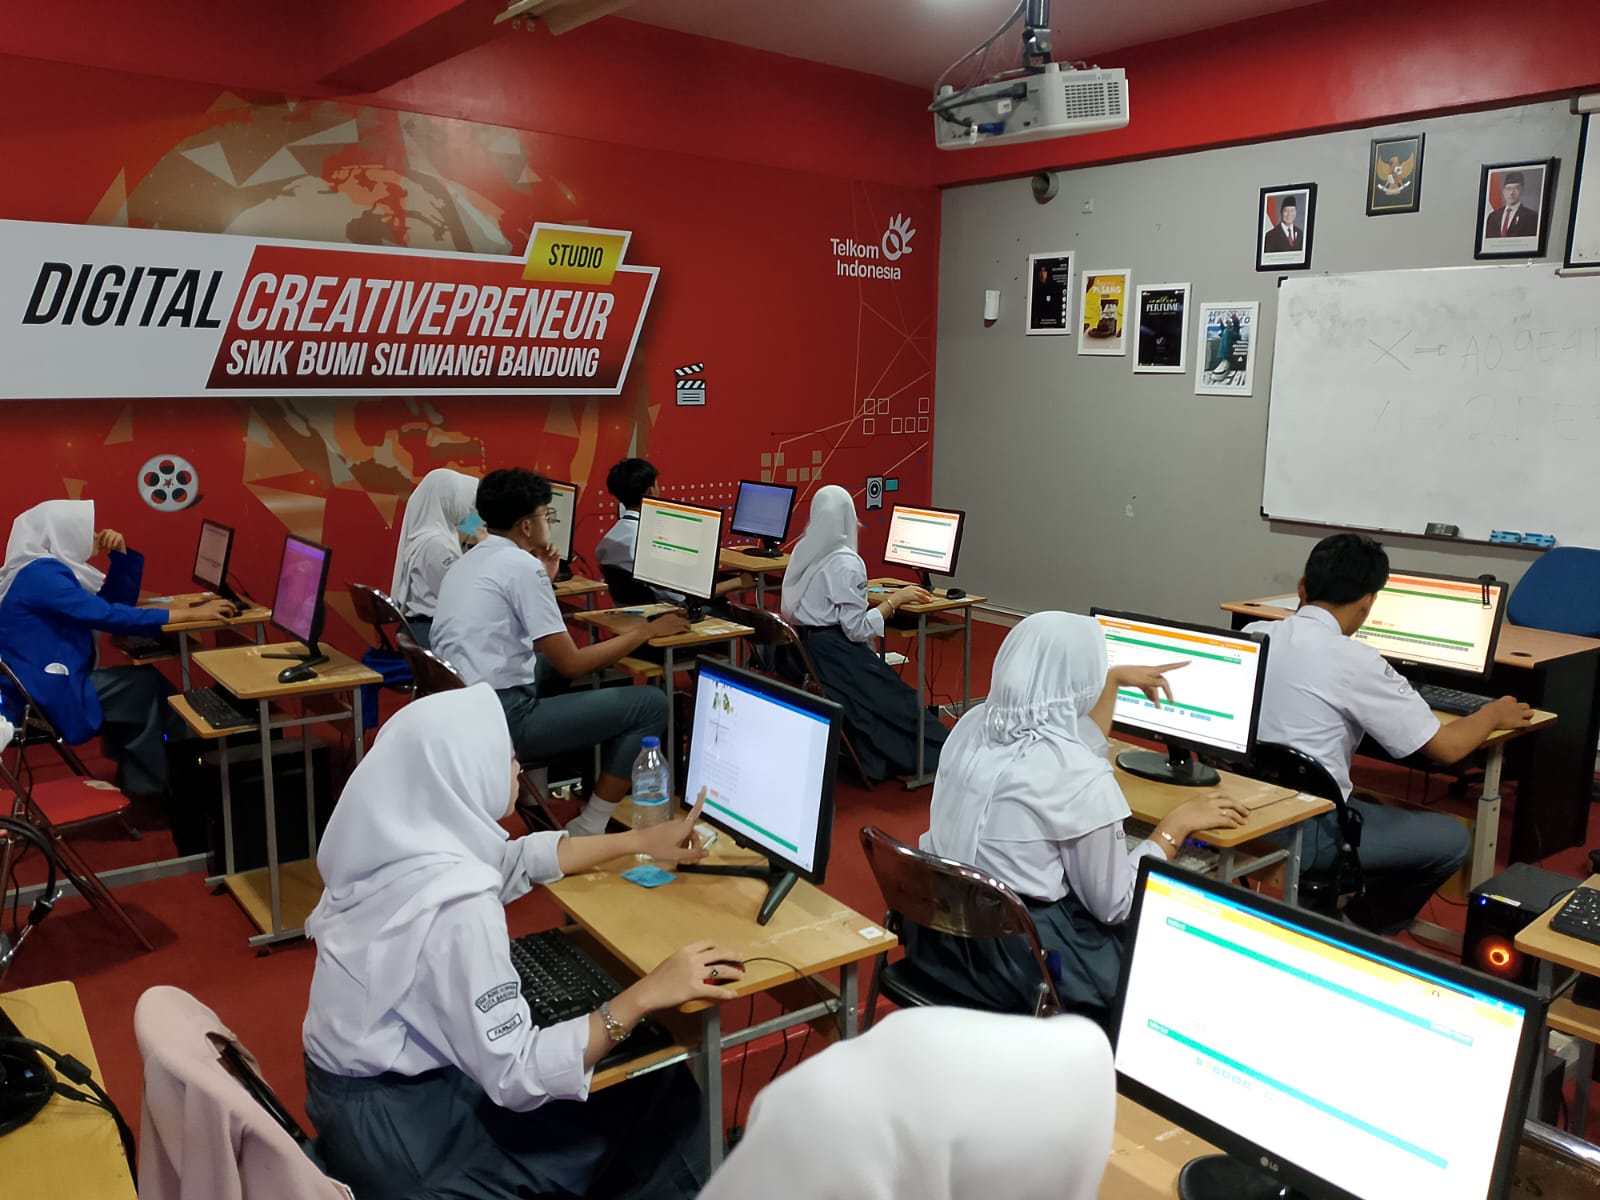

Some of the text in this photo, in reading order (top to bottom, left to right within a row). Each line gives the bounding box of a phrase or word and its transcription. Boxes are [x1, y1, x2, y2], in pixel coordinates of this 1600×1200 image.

[548, 243, 604, 269] STUDIO
[830, 238, 879, 259] Telkom
[837, 259, 901, 280] Indonesia
[21, 262, 615, 340] DIGITAL CREATIVEPRENEUR
[1146, 302, 1179, 312] PERFUME
[226, 339, 600, 377] SMK BUMI SILIWANGI BANDUNG
